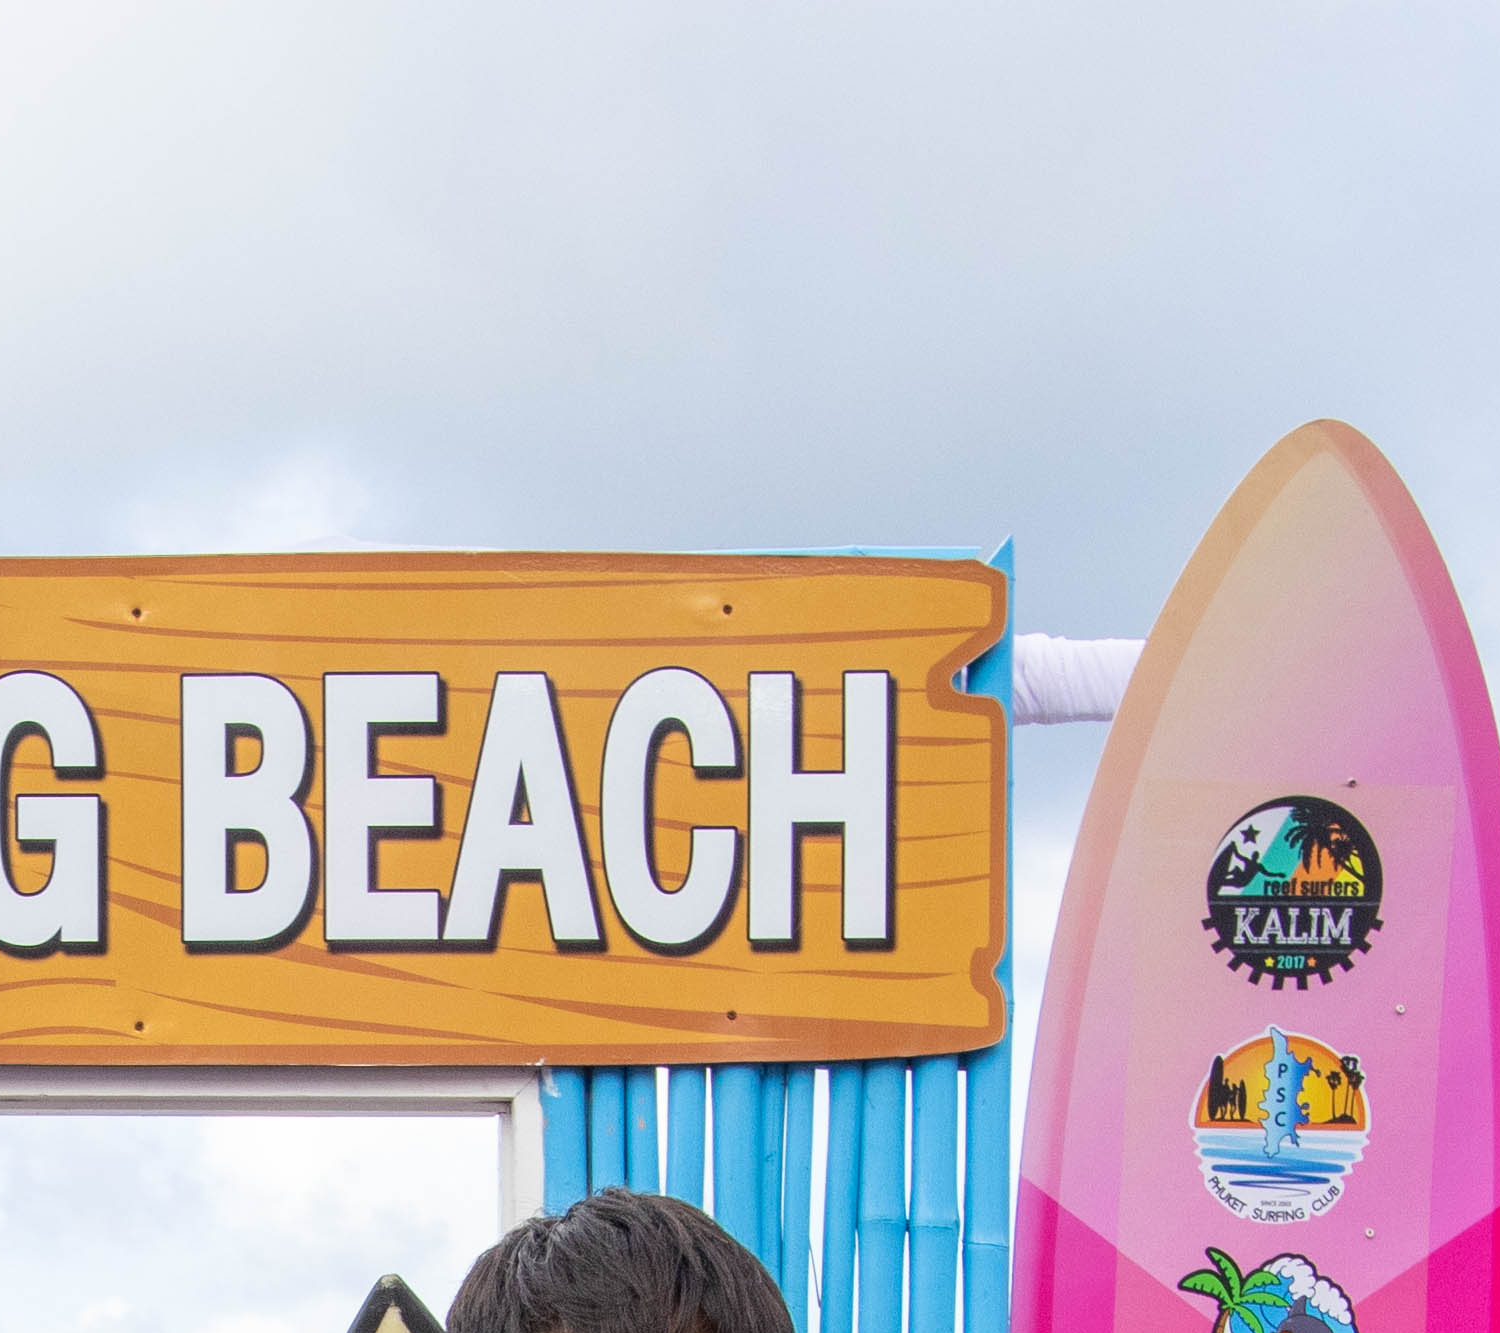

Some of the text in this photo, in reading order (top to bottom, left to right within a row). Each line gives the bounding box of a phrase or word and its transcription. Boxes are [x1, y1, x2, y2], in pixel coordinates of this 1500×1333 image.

[180, 667, 897, 951] BEACH
[1263, 877, 1360, 897] reef surfers
[1233, 907, 1353, 945] KALIM
[1276, 954, 1305, 969] 2017
[1207, 1175, 1341, 1223] PHUKET SURFING CLUB
